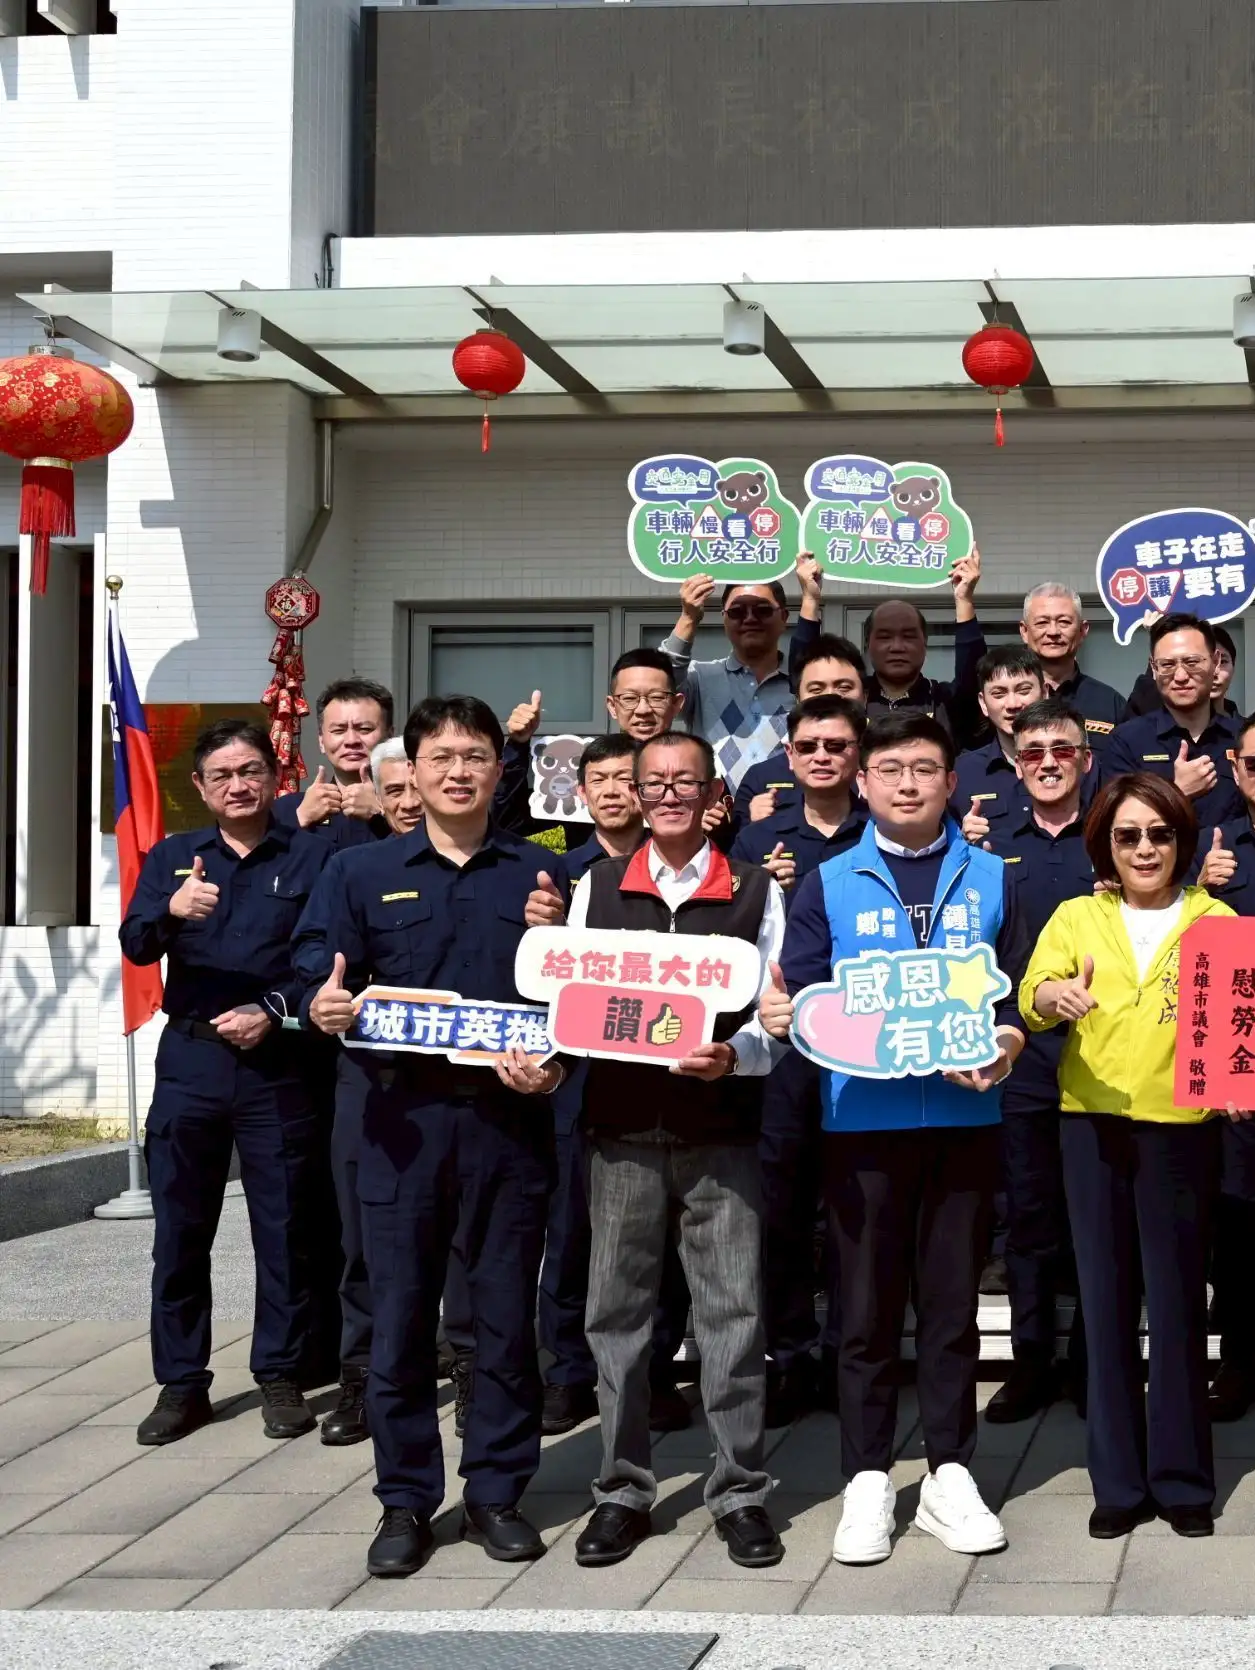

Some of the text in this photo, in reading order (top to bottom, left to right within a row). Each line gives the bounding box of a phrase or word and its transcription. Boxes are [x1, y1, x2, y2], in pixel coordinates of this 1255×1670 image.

[659, 540, 780, 565] 行人安全行
[828, 540, 947, 568] 行人安全行
[1135, 532, 1245, 568] 車子在走
[541, 949, 731, 988] 給你最大的
[845, 959, 947, 1014] 感恩
[361, 1002, 549, 1051] 城市英雄
[885, 1011, 990, 1066] 有您
[1188, 952, 1212, 1096] 高雄市議會 敬贈
